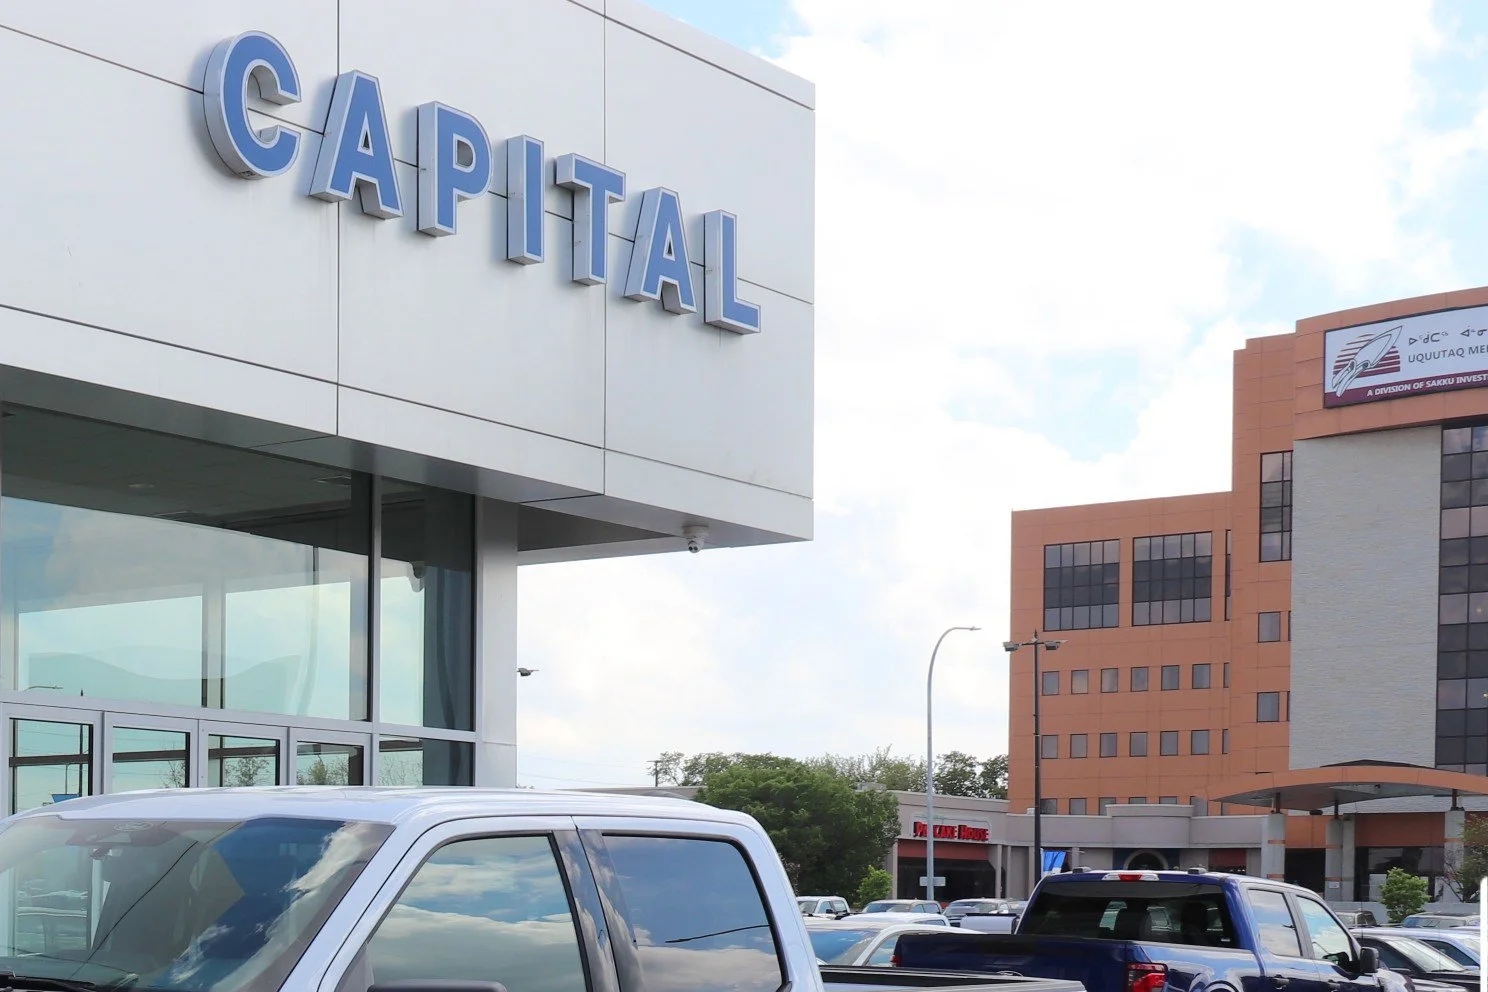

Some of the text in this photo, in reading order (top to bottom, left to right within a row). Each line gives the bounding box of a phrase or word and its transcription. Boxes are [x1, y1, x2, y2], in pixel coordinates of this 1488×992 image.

[204, 31, 761, 334] CAPITAL
[1408, 344, 1488, 363] UQUUTAQ ME
[1366, 389, 1373, 397] A
[1374, 383, 1412, 396] DIVISION
[1413, 381, 1424, 390] OF
[1425, 377, 1455, 388] SAKKU
[913, 821, 957, 838] PACAKE
